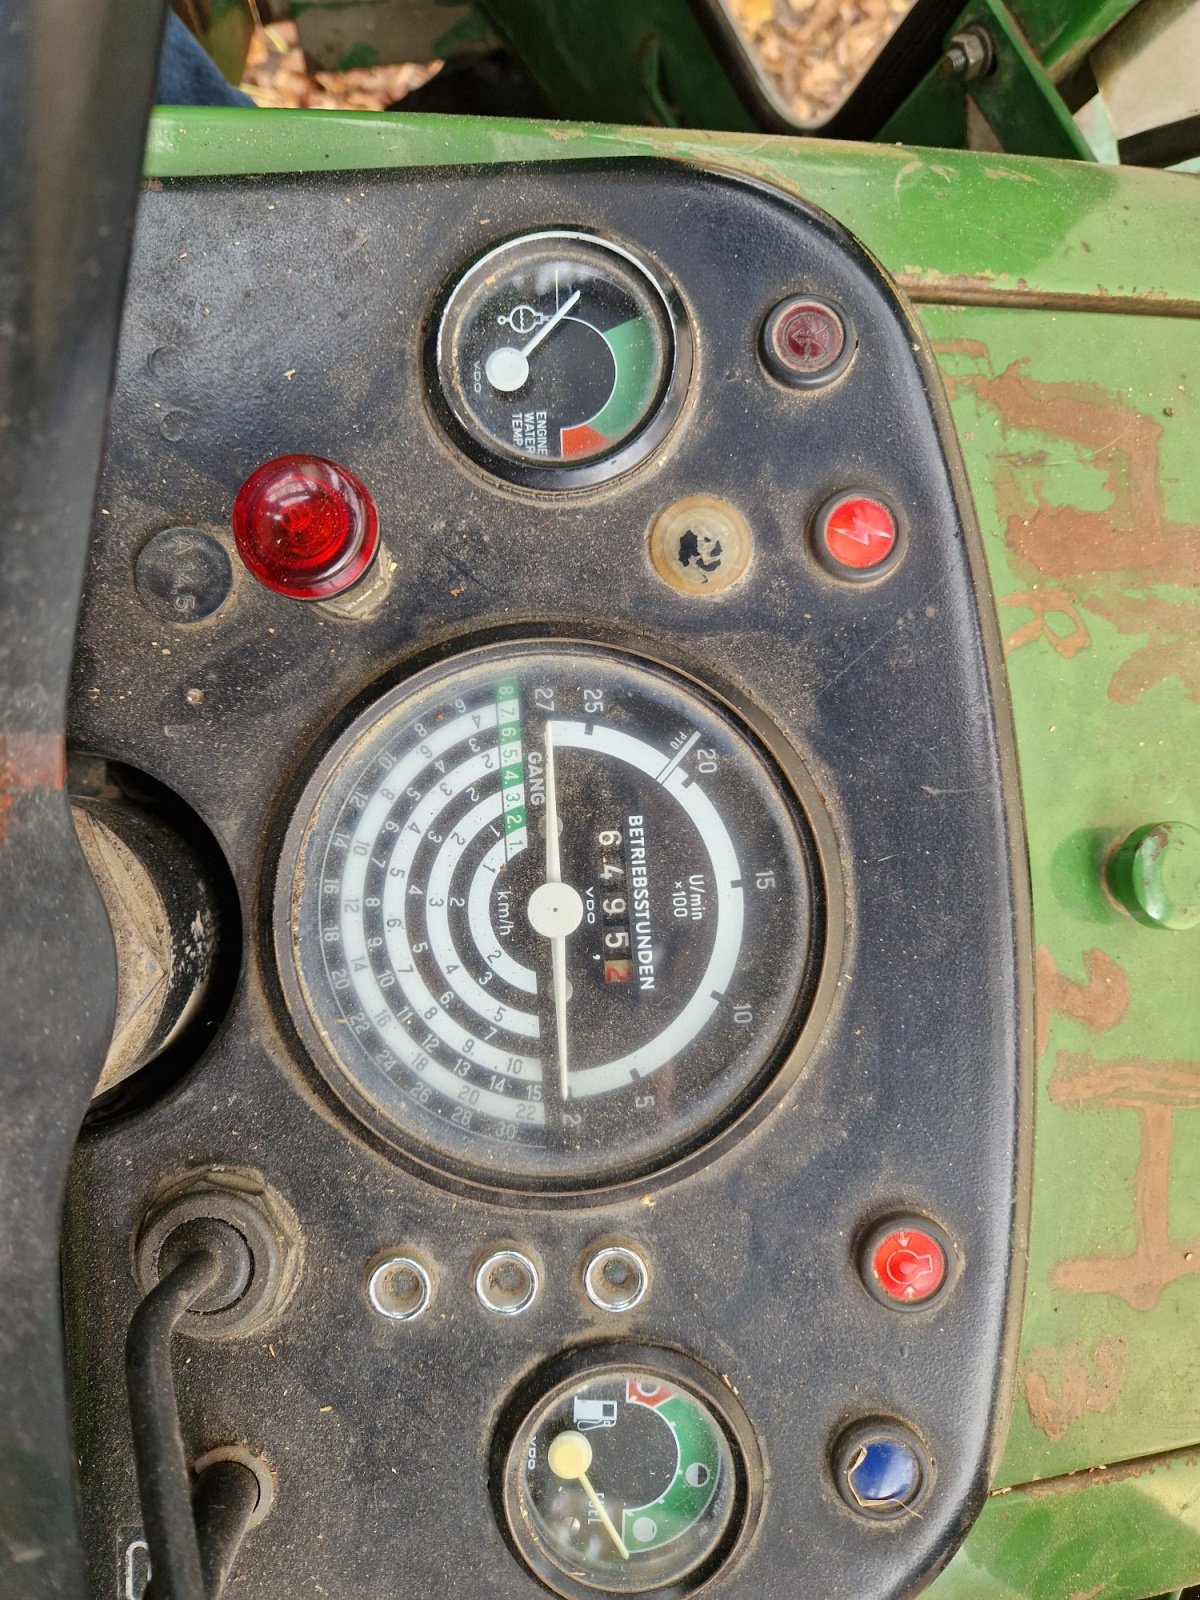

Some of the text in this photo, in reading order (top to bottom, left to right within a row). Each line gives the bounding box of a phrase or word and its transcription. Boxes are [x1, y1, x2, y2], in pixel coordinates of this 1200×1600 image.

[524, 412, 535, 454] WATER
[536, 411, 548, 456] ENGINE
[534, 687, 553, 711] 27
[584, 689, 604, 713] 25
[414, 723, 427, 737] 8
[471, 714, 481, 729] 4
[468, 738, 480, 752] 3
[670, 731, 687, 749] PTO
[377, 751, 397, 769] 10
[434, 759, 445, 773] 4
[481, 753, 493, 769] 2
[696, 749, 717, 773] 20
[528, 752, 544, 806] GANG
[381, 788, 395, 801] 8
[406, 787, 421, 801] 5
[439, 783, 452, 796] 3
[465, 786, 479, 801] 2
[349, 790, 368, 808] 12
[407, 822, 421, 834] 4
[332, 832, 350, 849] 14
[428, 831, 442, 843] 3
[353, 840, 370, 856] 10
[372, 857, 386, 868] 7
[390, 867, 405, 878] 5
[756, 870, 774, 889] 15
[324, 878, 339, 894] 16
[408, 885, 423, 895] 4
[344, 898, 360, 913] 12
[365, 897, 380, 907] 8
[587, 887, 595, 924] VDO
[628, 815, 654, 991] BETRIEBSSTUNDEN
[688, 875, 705, 920] U/min
[497, 891, 512, 936] km/h
[324, 925, 339, 942] 18
[429, 832, 506, 1022] 2 3 4 5
[412, 942, 428, 953] 5
[450, 897, 464, 906] 2
[478, 971, 493, 985] 3
[351, 957, 365, 972] 14
[487, 950, 501, 964] 2
[398, 965, 413, 973] 7
[331, 970, 350, 990] 20
[377, 970, 395, 988] 10
[373, 1010, 391, 1026] 16
[397, 1005, 413, 1022] 11
[424, 1007, 438, 1020] 8
[734, 1003, 751, 1023] 10
[349, 1012, 370, 1035] 22
[484, 1026, 497, 1041] 7
[421, 1034, 440, 1054] 12
[410, 1053, 429, 1072] 18
[452, 1058, 471, 1076] 13
[507, 1058, 523, 1074] 10
[489, 1075, 506, 1093] 14
[457, 1086, 480, 1105] 20
[526, 1085, 542, 1101] 15
[635, 1096, 653, 1107] 5
[516, 1104, 537, 1121] 22
